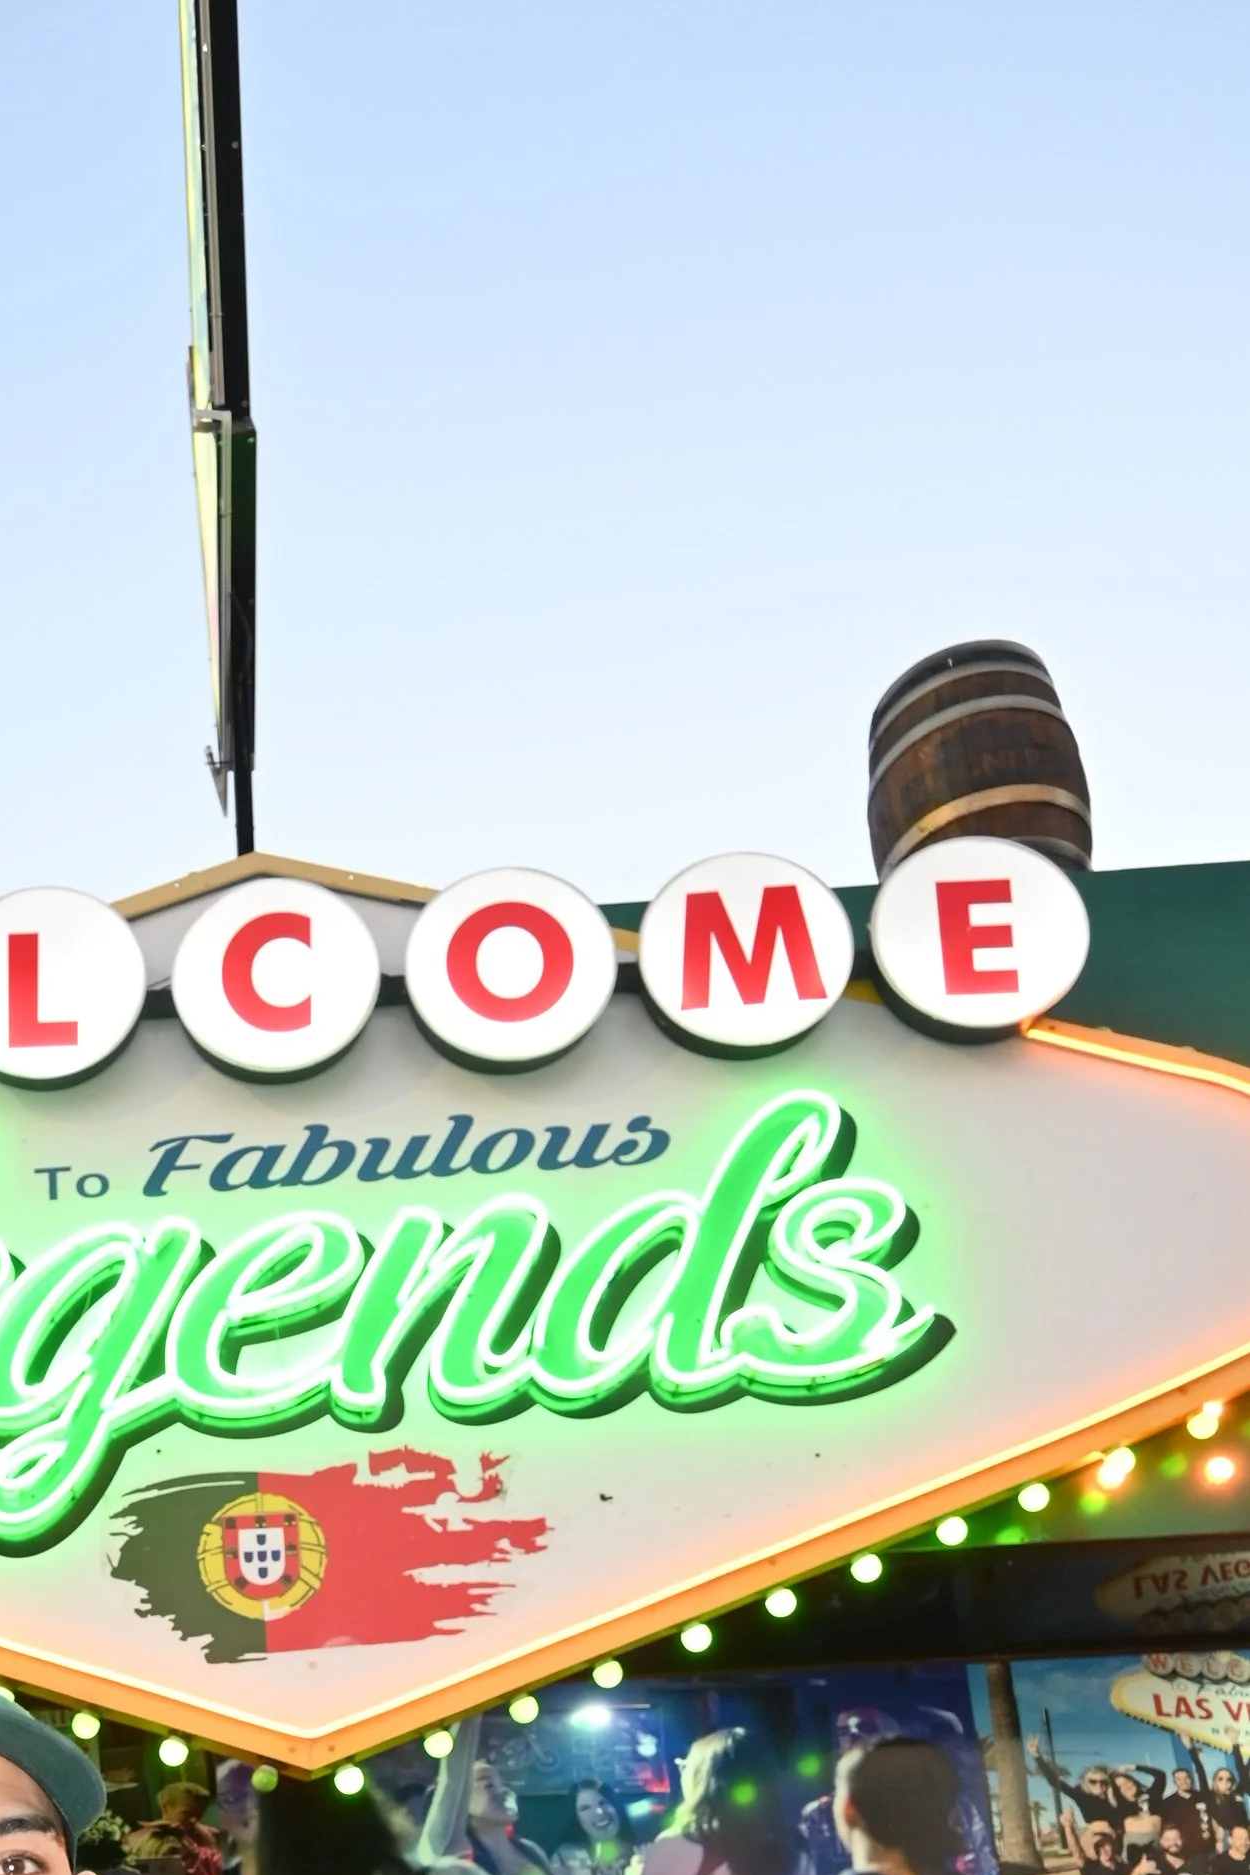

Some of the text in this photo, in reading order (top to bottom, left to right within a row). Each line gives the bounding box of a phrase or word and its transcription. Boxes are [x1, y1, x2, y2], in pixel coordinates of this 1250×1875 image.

[34, 1114, 671, 1202] To Fabulous
[1152, 1692, 1214, 1721] LAS
